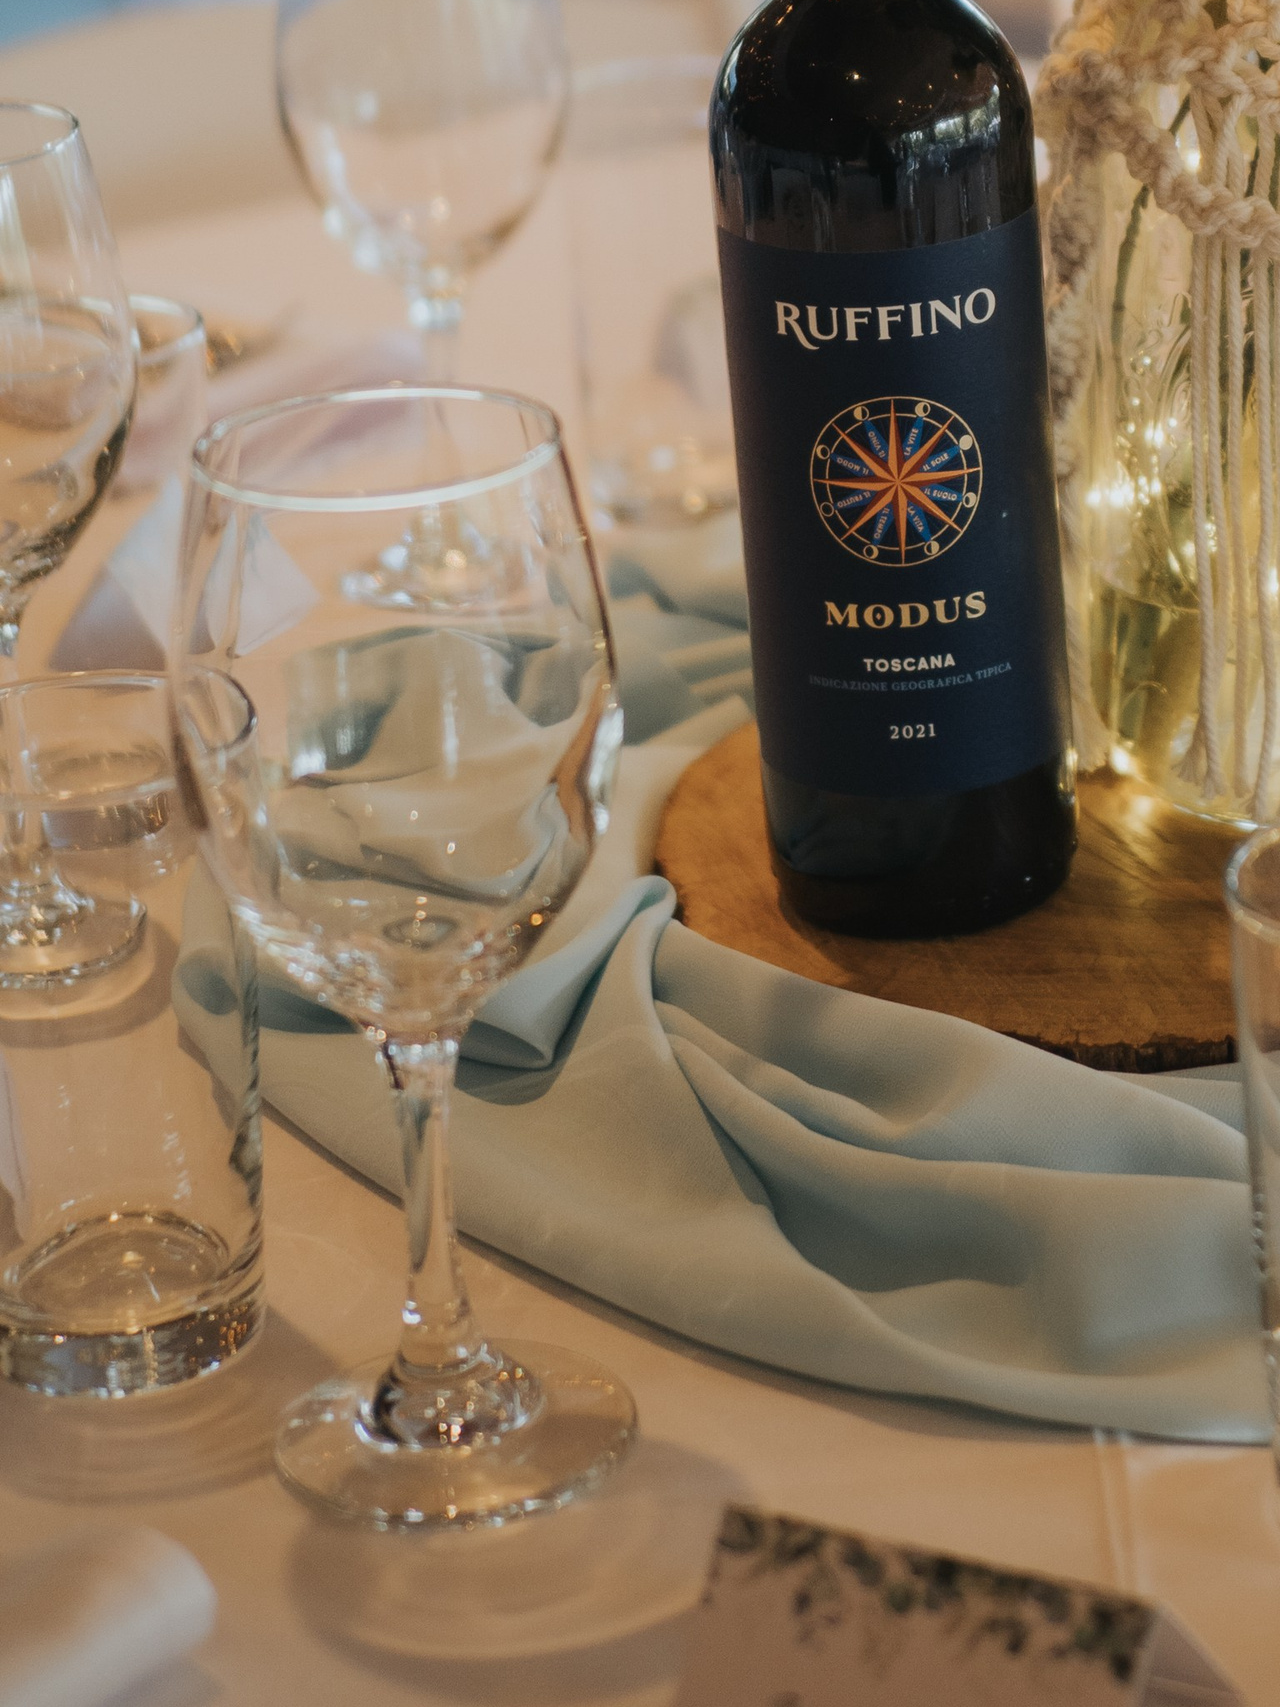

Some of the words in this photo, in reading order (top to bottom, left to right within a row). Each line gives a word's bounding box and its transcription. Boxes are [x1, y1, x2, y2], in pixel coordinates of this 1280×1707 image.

[775, 287, 997, 350] RUFFINO
[867, 430, 882, 450] VINO
[903, 445, 913, 457] LA
[908, 427, 919, 445] VITE
[836, 457, 862, 472] MODO
[930, 452, 950, 467] SOLE
[836, 492, 864, 508] FRUTTO
[932, 489, 958, 502] SUOLO
[873, 514, 888, 540] TEMPO
[912, 516, 926, 534] VITA
[825, 591, 987, 629] MODUS
[863, 653, 956, 672] TOSCANA
[808, 674, 889, 692] INDICAZIONE
[891, 673, 974, 691] GEOGRAFICA
[975, 662, 1012, 681] TIPICA
[889, 722, 937, 740] 2021
